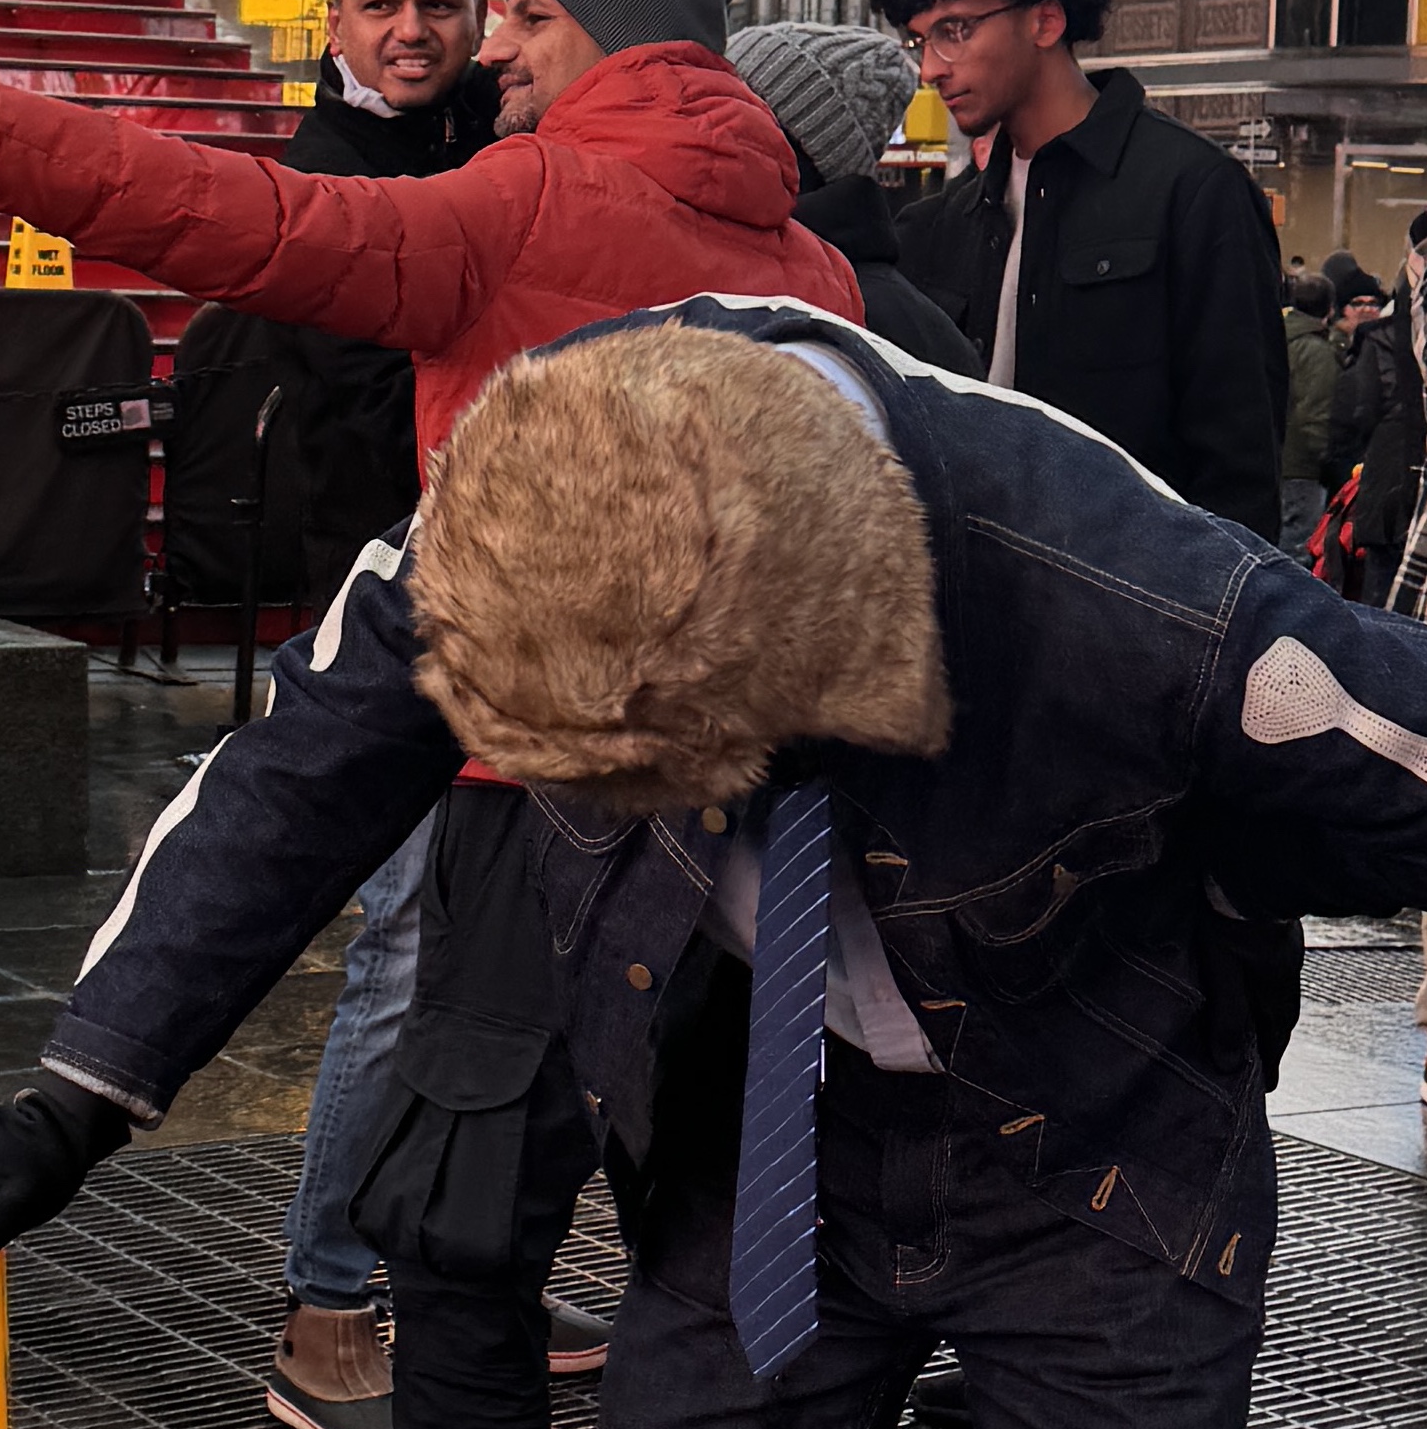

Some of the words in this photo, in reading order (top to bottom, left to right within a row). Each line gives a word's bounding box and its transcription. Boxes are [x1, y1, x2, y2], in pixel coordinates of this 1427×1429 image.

[37, 249, 60, 261] WET
[32, 264, 65, 276] FLOOR
[66, 402, 114, 420] STEPS
[62, 418, 121, 438] CLOSED
